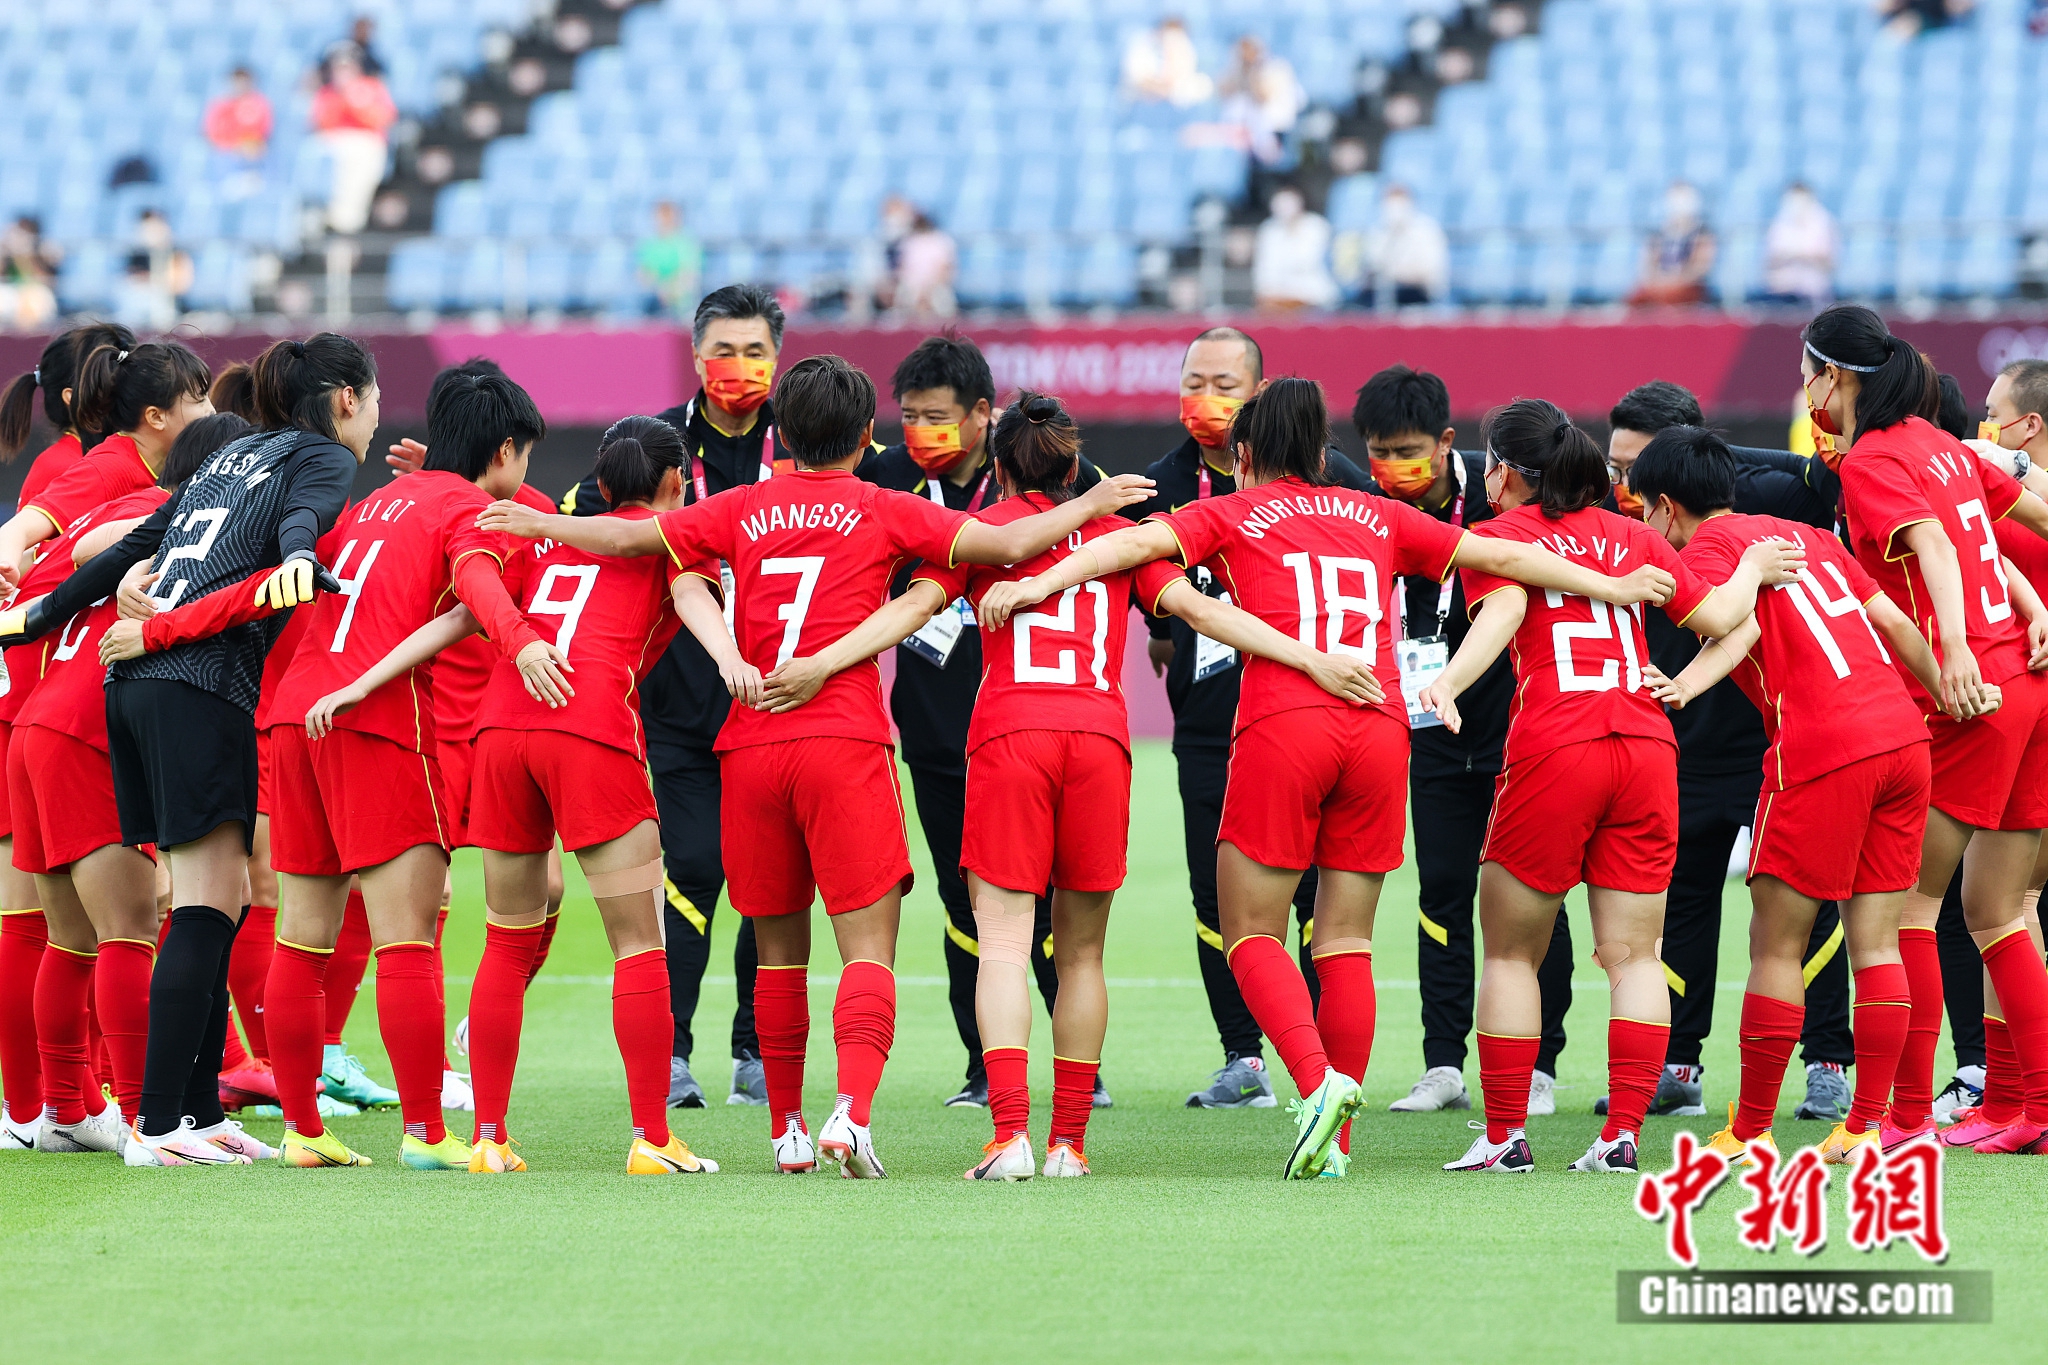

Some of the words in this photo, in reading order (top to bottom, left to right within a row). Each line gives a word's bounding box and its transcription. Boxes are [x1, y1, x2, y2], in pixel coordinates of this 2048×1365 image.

[740, 502, 863, 542] WANGSH
[1237, 496, 1389, 540] WURIGUMULA
[1955, 498, 2012, 625] 3
[323, 539, 385, 654] 4
[527, 564, 601, 664] 9
[760, 556, 826, 669] 7
[1013, 576, 1110, 692] 21
[1282, 551, 1384, 667] 18
[1771, 560, 1892, 680] 14
